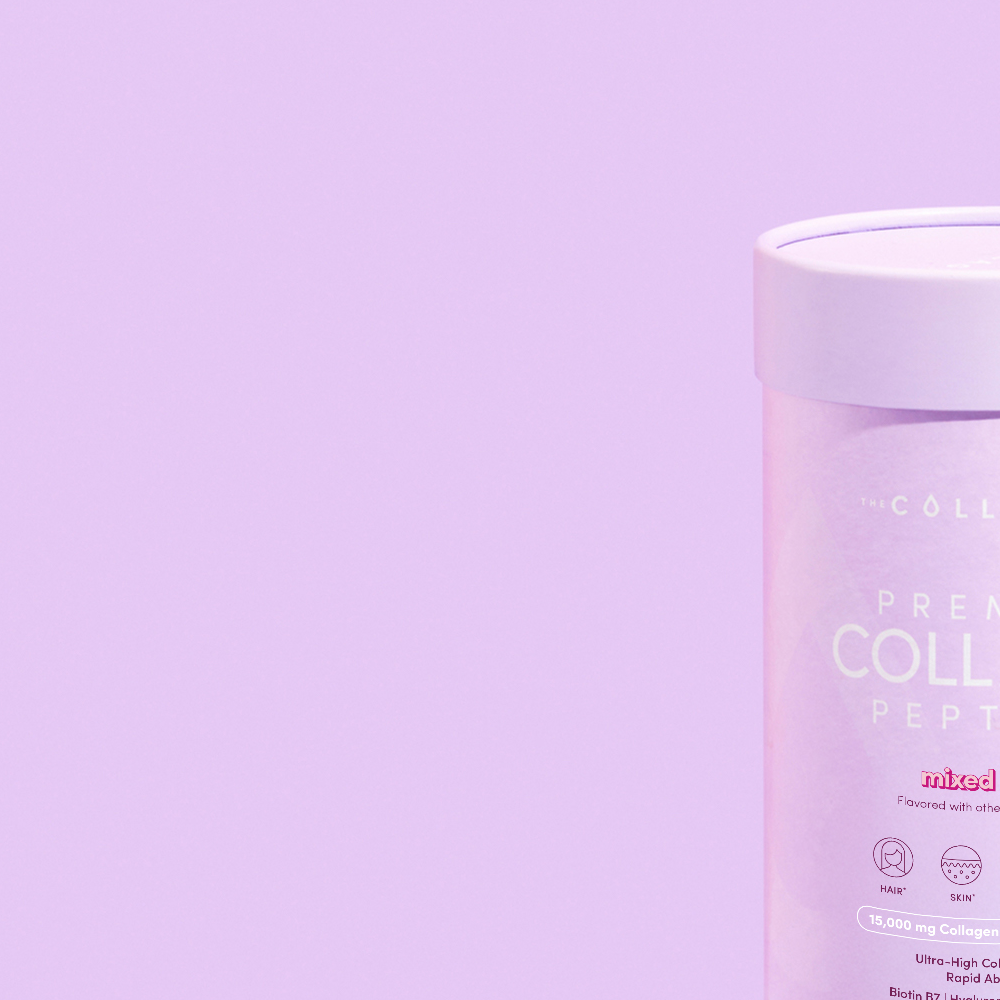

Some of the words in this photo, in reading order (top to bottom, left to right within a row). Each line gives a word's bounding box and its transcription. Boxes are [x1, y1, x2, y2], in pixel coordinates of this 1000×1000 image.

[860, 497, 886, 509] THE
[921, 766, 996, 792] mixed
[897, 795, 946, 811] Flavored
[949, 801, 973, 813] with
[868, 913, 913, 931] 15,000
[913, 923, 936, 940] mg
[939, 923, 999, 940] Collagen
[915, 953, 978, 971] Ultra-High
[946, 971, 981, 986] Rapid
[889, 986, 923, 1000] Biotin
